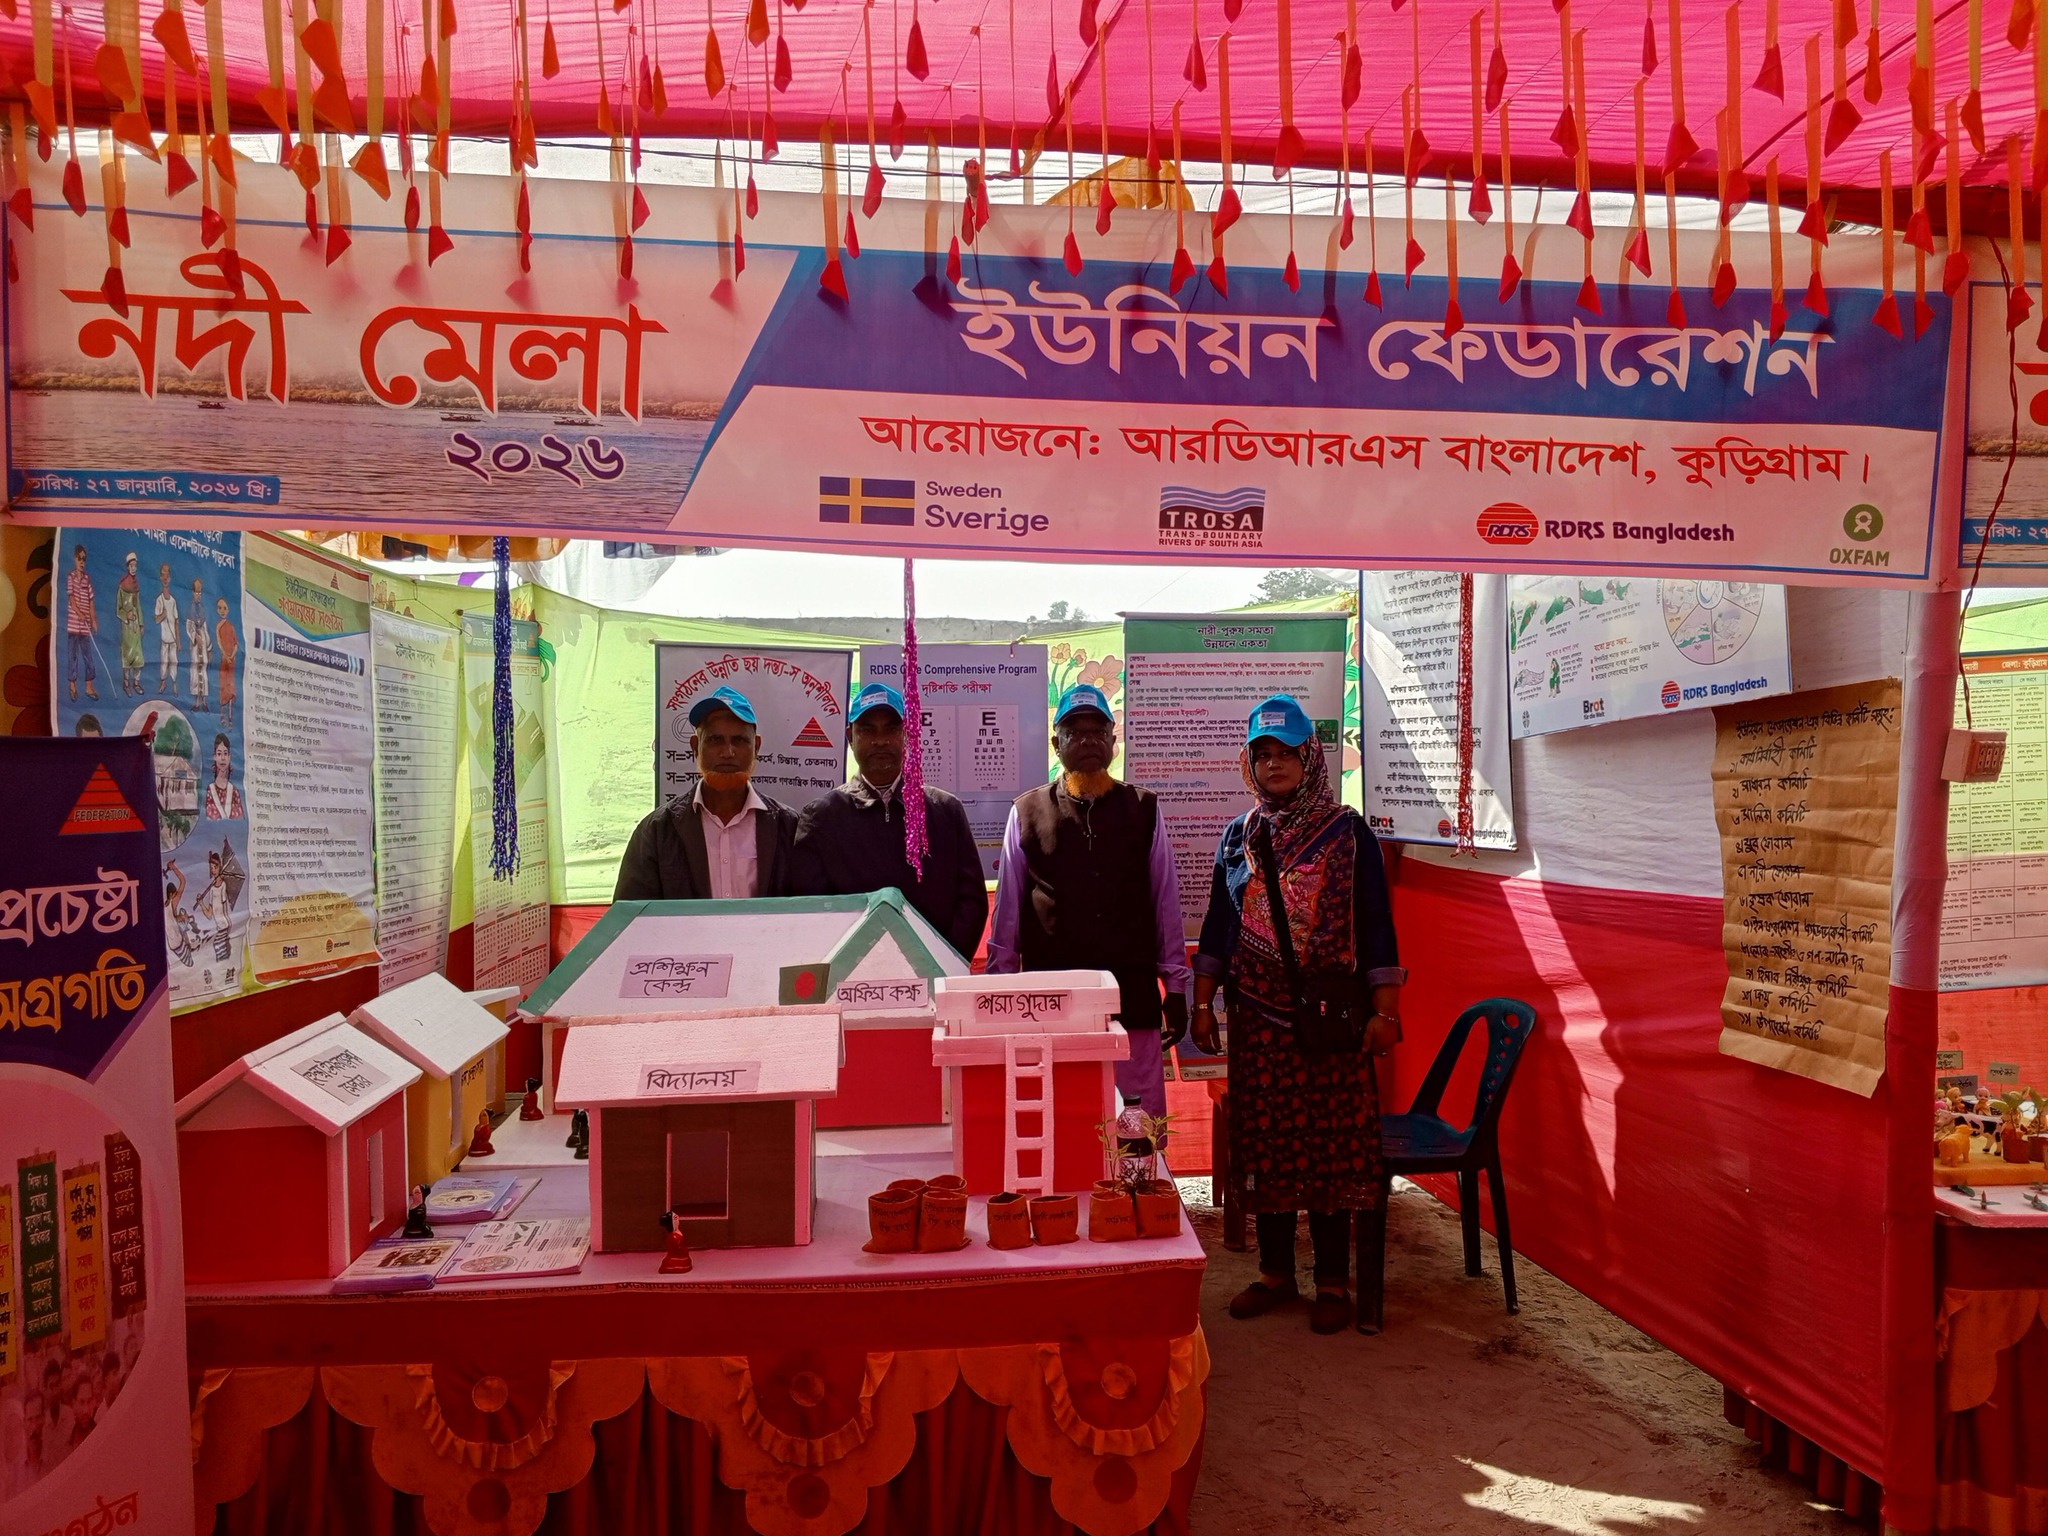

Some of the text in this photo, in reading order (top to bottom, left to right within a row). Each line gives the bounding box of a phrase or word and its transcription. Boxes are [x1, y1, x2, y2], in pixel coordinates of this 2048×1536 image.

[59, 252, 669, 424] নদী মেলা
[948, 276, 1835, 400] ইউনিয়ন ফেডারেশন
[446, 431, 625, 487] ২০২৬
[859, 415, 1100, 459] আয়োজনে:
[1120, 419, 1430, 472] আরডিআরএস
[1442, 434, 1657, 486] বাংলাদেশ,
[86, 477, 109, 495] ২৭
[115, 474, 182, 500] জানুয়ারি,
[188, 479, 240, 497] ২০২৬
[926, 481, 1002, 498] Sweden
[925, 504, 1048, 537] Sverige
[1166, 511, 1254, 530] TROSA
[1158, 530, 1263, 540] TRANS-BOUNDARY
[1545, 520, 1735, 545] RDRS Bangladesh
[1158, 539, 1263, 548] RIVERS OF SOUTH ASIA
[1830, 548, 1890, 567] OXFAM
[1247, 626, 1275, 635] সমতা
[1203, 638, 1267, 649] উন্নয়নে একতা
[870, 664, 1037, 677] RDRS Comprehensive Program
[665, 669, 710, 712] সংগঠনের
[705, 654, 740, 681] উন্নতি
[742, 656, 761, 674] ছয়
[801, 671, 841, 717] অনুশীলনে
[962, 680, 992, 694] পরীক্ষা
[1683, 676, 1768, 701] RDRS Bangladesh
[1583, 698, 1605, 714] Brot
[73, 809, 131, 822] FEDERATION
[1369, 815, 1395, 829] Brot
[0, 866, 140, 948] প্রচেষ্টা
[643, 977, 696, 997] কেন্দ্র
[836, 982, 923, 1005] অফিস কক্ষ
[1015, 993, 1068, 1022] গুদাম
[646, 1068, 747, 1091] বিদ্যালয়
